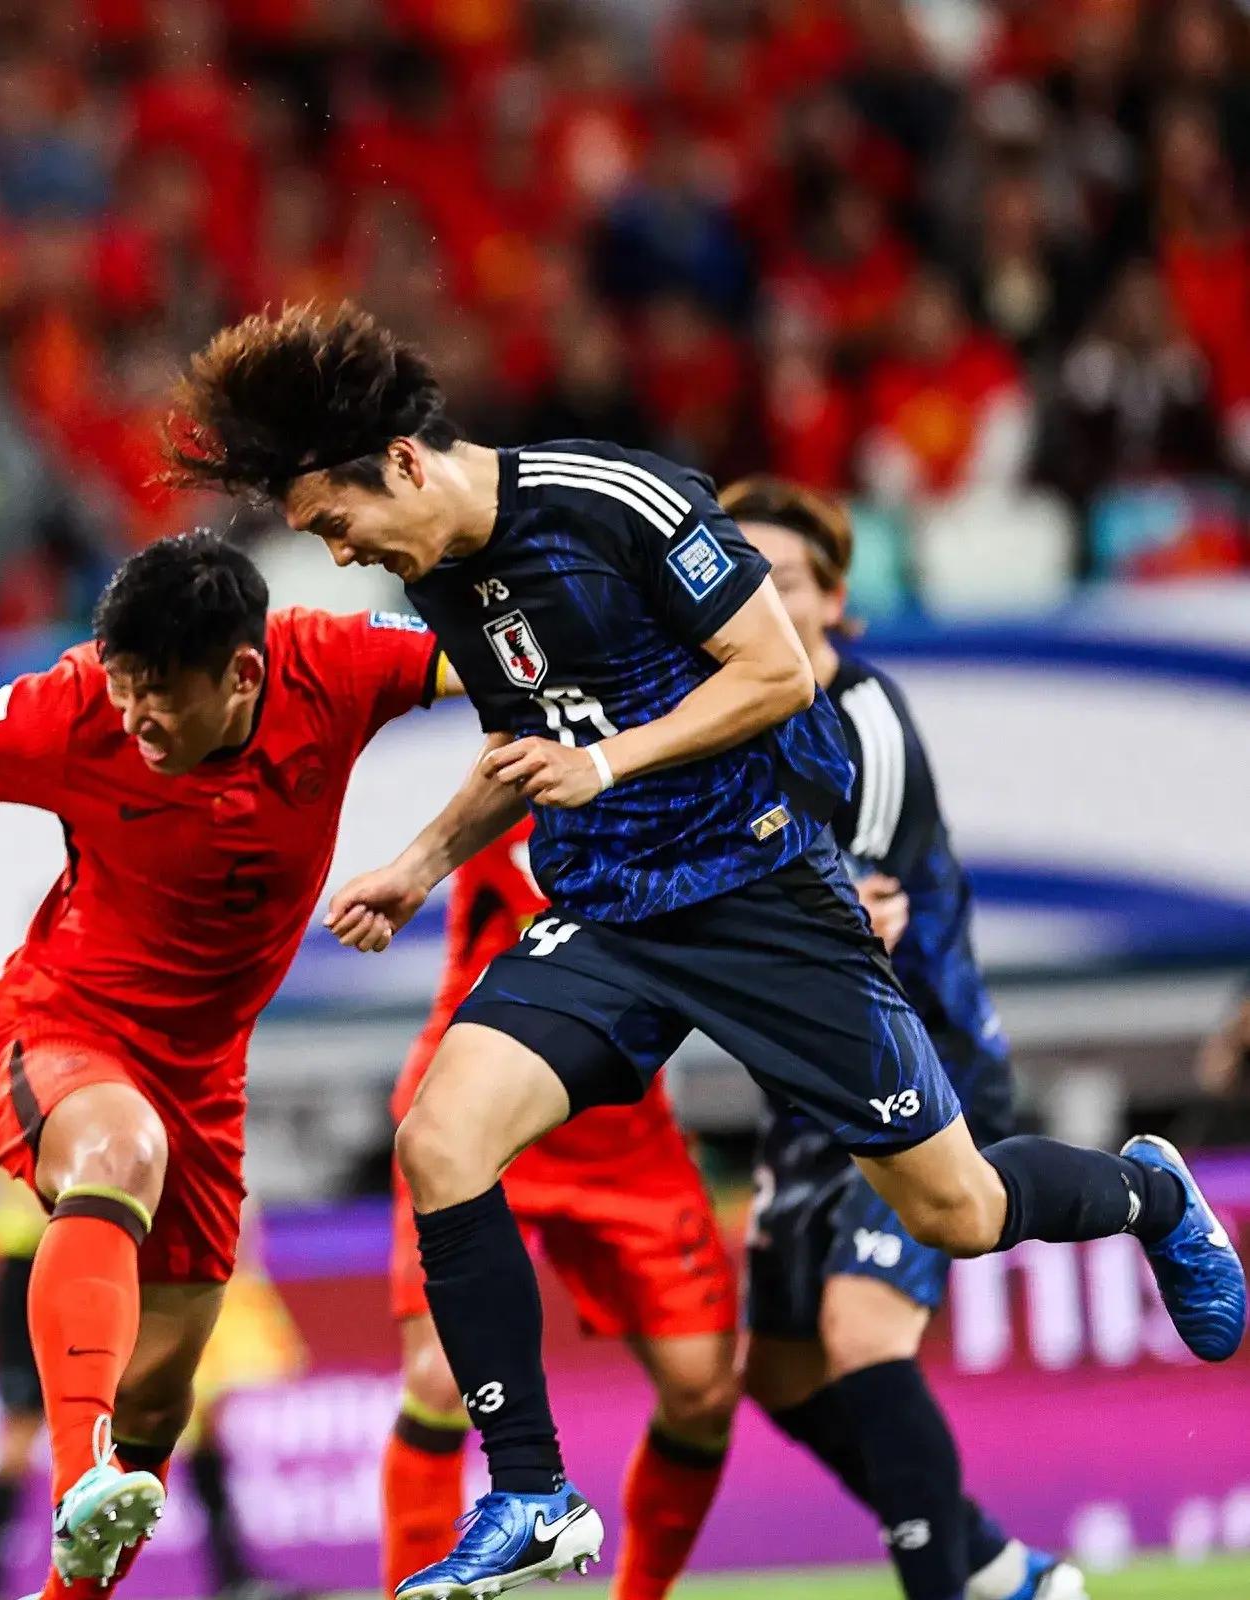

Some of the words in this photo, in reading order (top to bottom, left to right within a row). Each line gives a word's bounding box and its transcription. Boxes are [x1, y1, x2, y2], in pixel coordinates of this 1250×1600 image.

[473, 578, 510, 608] Y-3
[224, 851, 269, 915] 5
[519, 917, 581, 957] 4
[869, 1089, 920, 1124] Y-3
